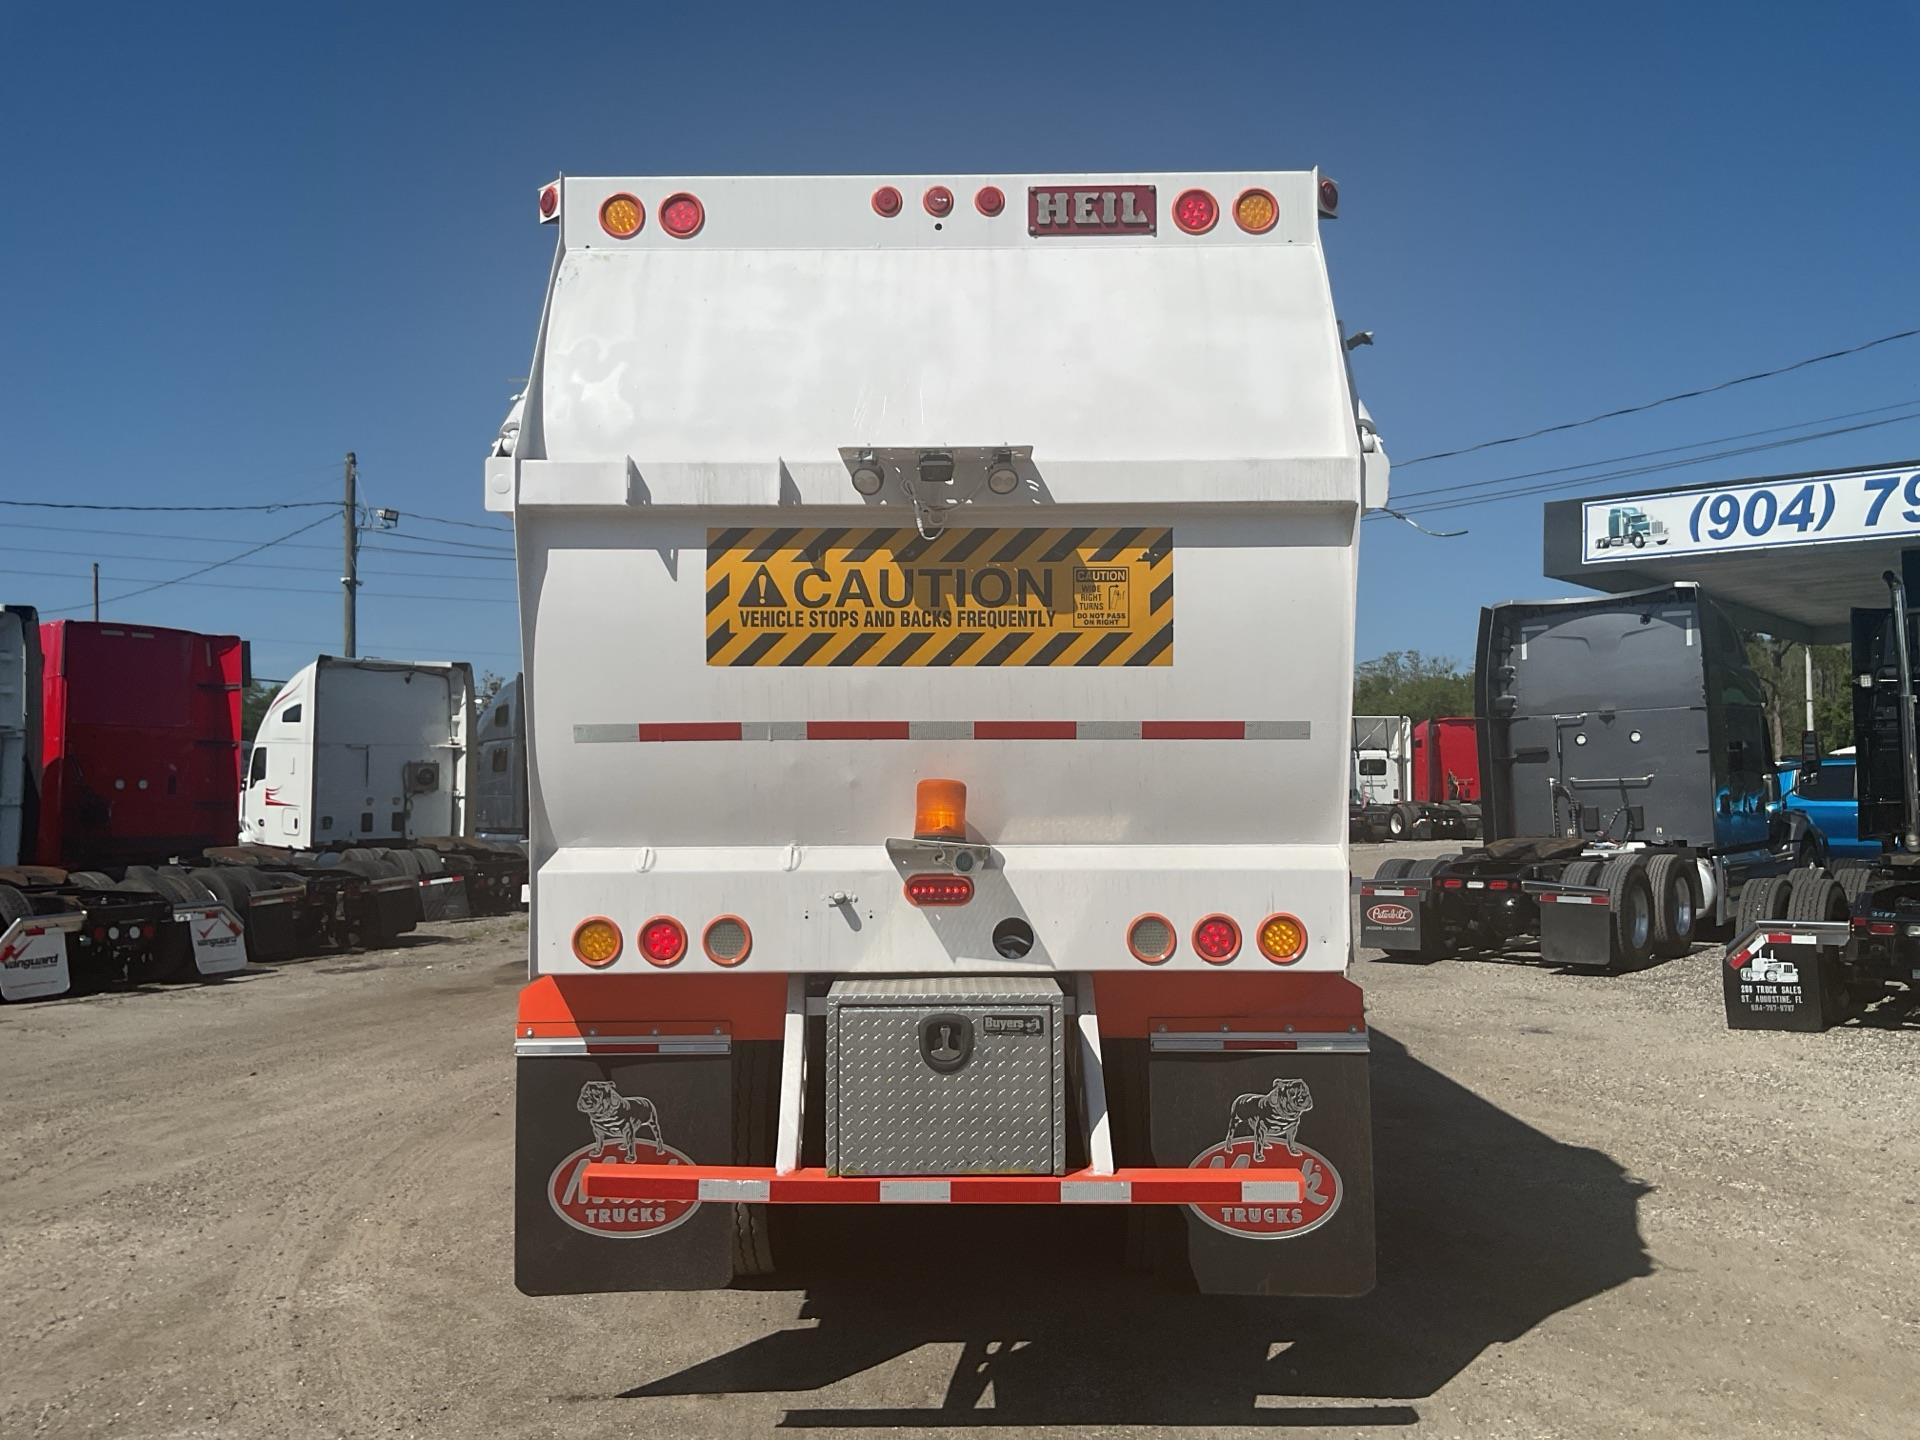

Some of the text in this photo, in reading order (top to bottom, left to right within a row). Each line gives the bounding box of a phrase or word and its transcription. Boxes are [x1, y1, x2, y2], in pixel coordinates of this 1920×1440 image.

[1036, 191, 1148, 224] HEIL
[1689, 483, 1836, 542] (904)
[1077, 571, 1125, 580] CAUTION
[793, 567, 1053, 609] CAUTION
[740, 610, 1056, 629] VEHICLE STOPS AND BACKS FREQUENTLY
[1372, 907, 1409, 920] Peterbilt
[1756, 985, 1778, 994] TRUCK
[1781, 985, 1802, 995] SALES
[1795, 995, 1804, 1004] FL
[984, 1017, 1024, 1030] Buyers
[585, 1207, 666, 1224] TRUCKS
[1221, 1207, 1303, 1224] TRUCKS
